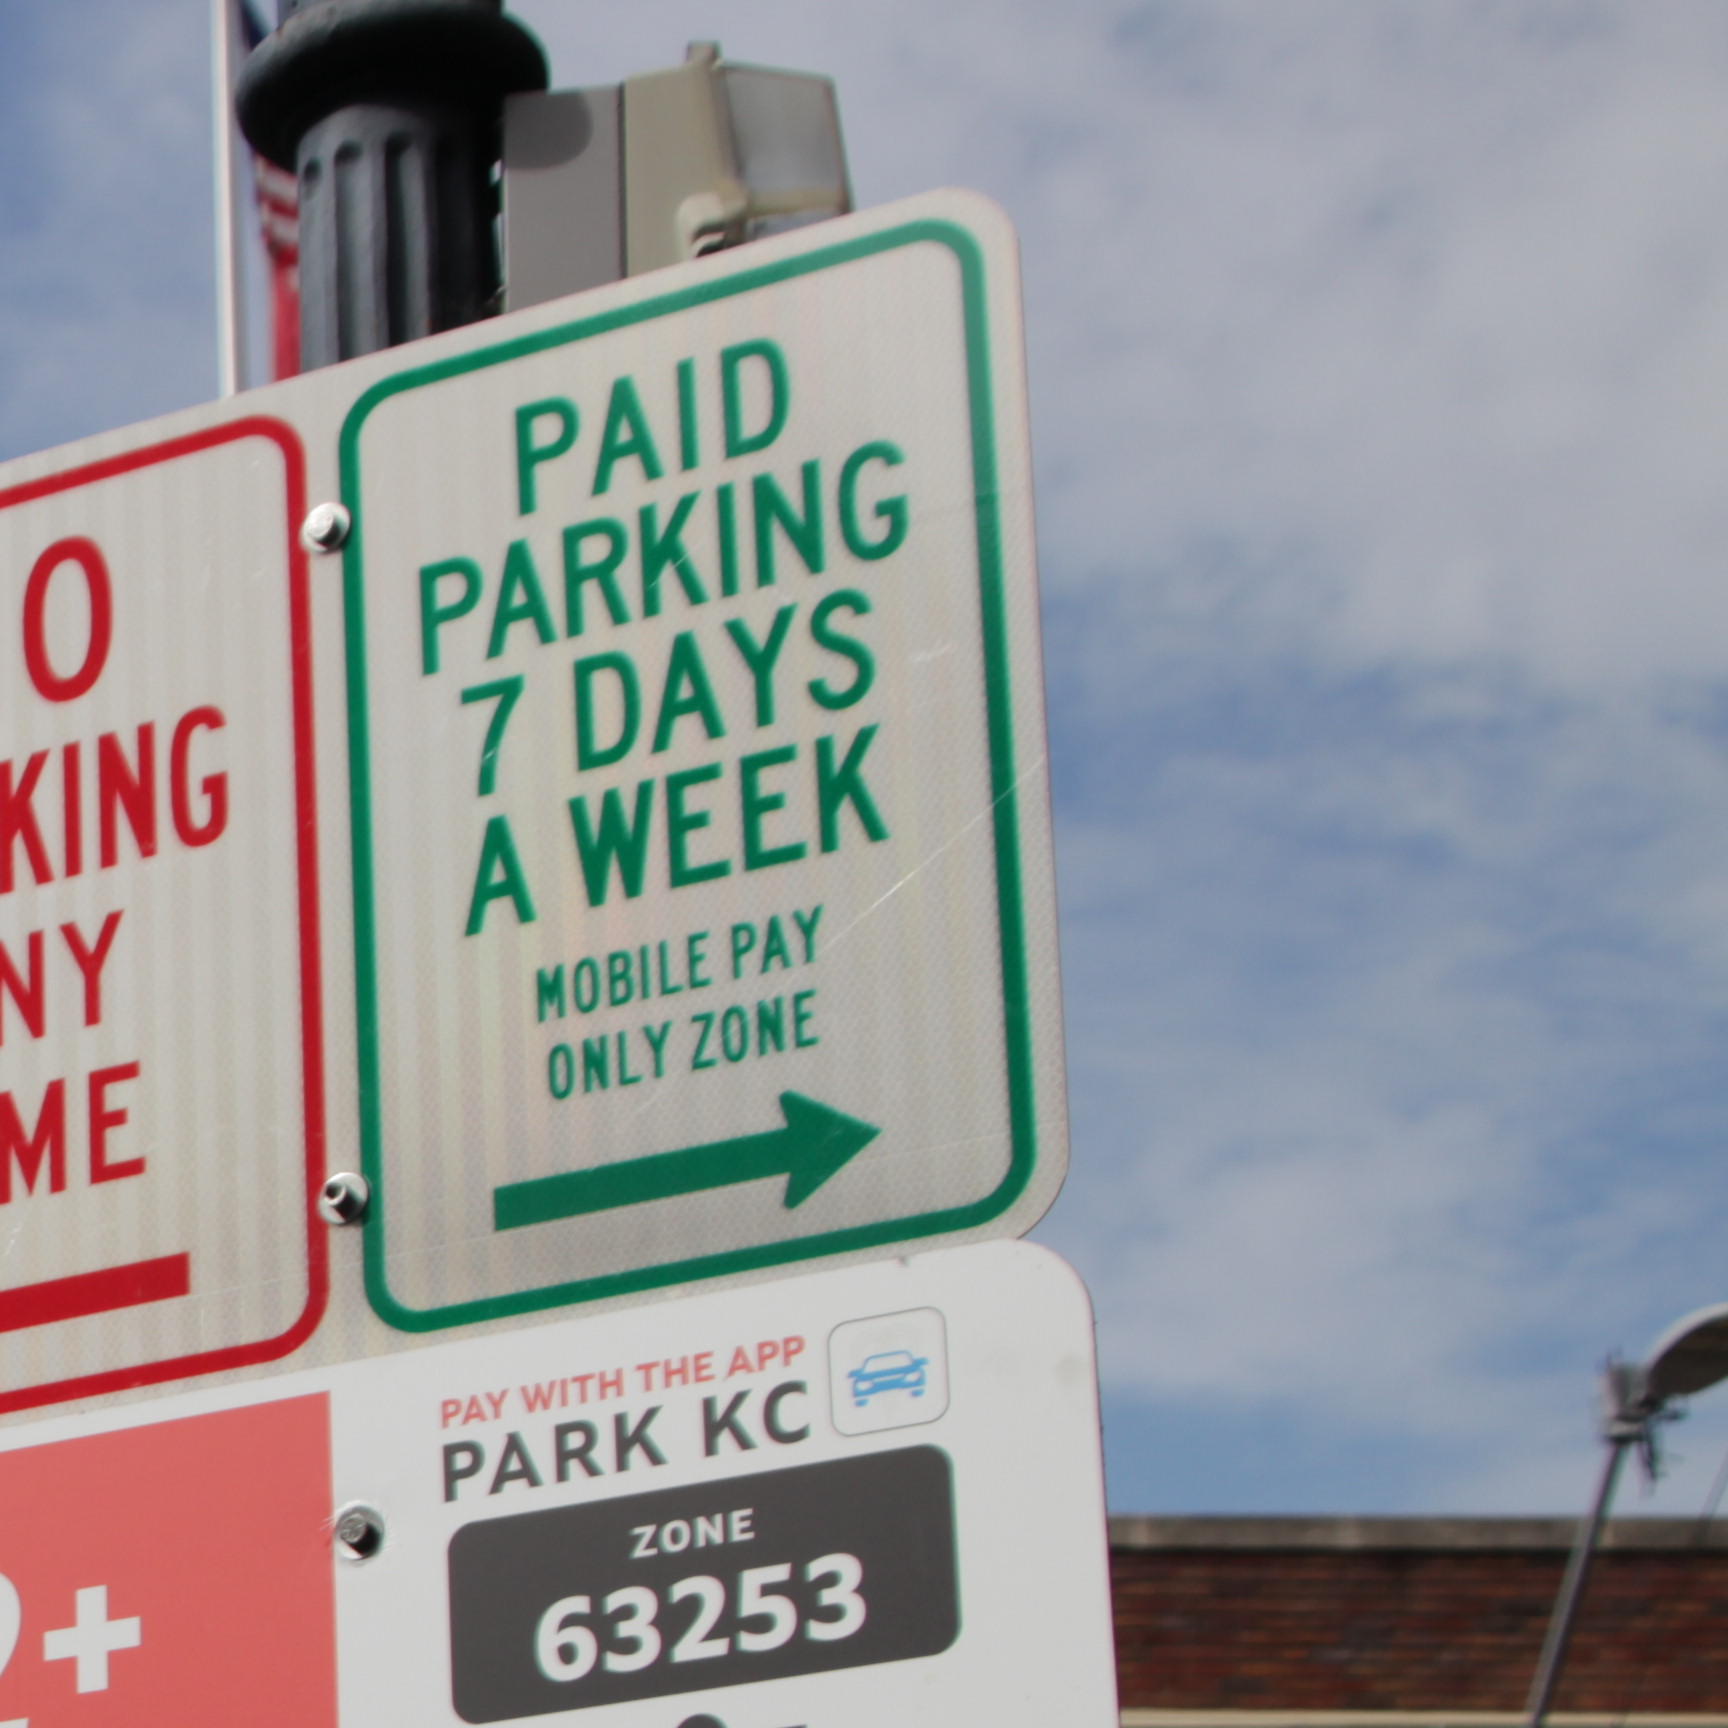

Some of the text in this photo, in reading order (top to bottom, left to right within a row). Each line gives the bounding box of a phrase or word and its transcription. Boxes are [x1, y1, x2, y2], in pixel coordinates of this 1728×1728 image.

[514, 339, 789, 515] PAID
[418, 441, 910, 677] PARKING
[460, 588, 876, 798] 7 DAYS
[464, 724, 887, 937] A WEEK
[534, 906, 824, 1022] MOBILE PAY
[546, 990, 819, 1102] ONLY ZONE
[441, 1336, 806, 1429] PAY WITH THE APP
[442, 1381, 812, 1502] PARK KC
[630, 1508, 755, 1559] ZONE
[535, 1552, 866, 1682] 63253
